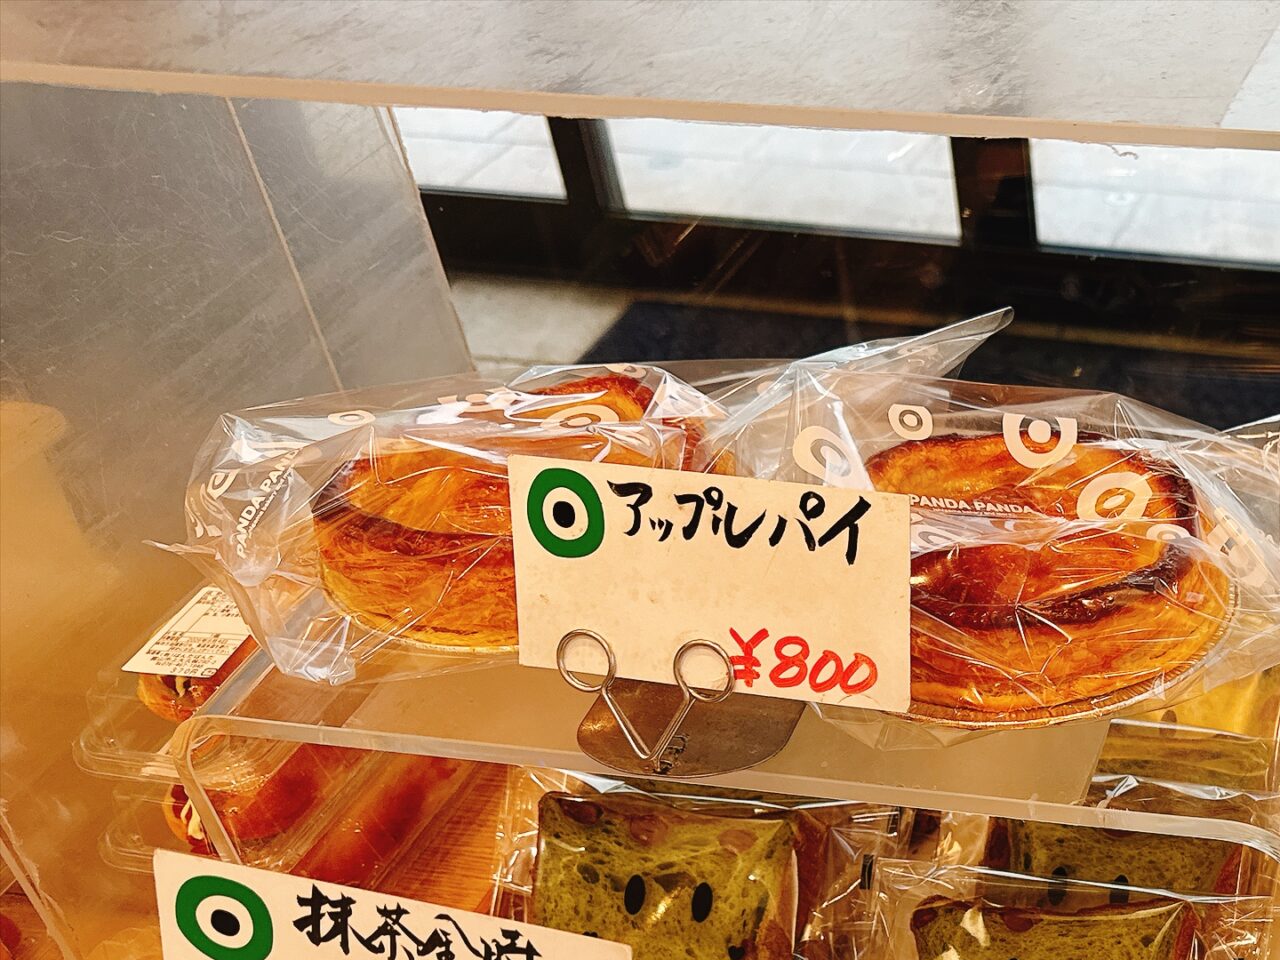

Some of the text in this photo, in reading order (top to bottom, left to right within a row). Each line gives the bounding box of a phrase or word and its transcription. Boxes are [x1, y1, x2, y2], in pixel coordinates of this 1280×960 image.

[236, 496, 266, 560] PANDA
[259, 449, 301, 493] PAND
[606, 479, 872, 566] アップルパイ
[907, 493, 972, 511] PANDA
[973, 499, 1035, 515] PANDA
[725, 626, 879, 695] ¥800
